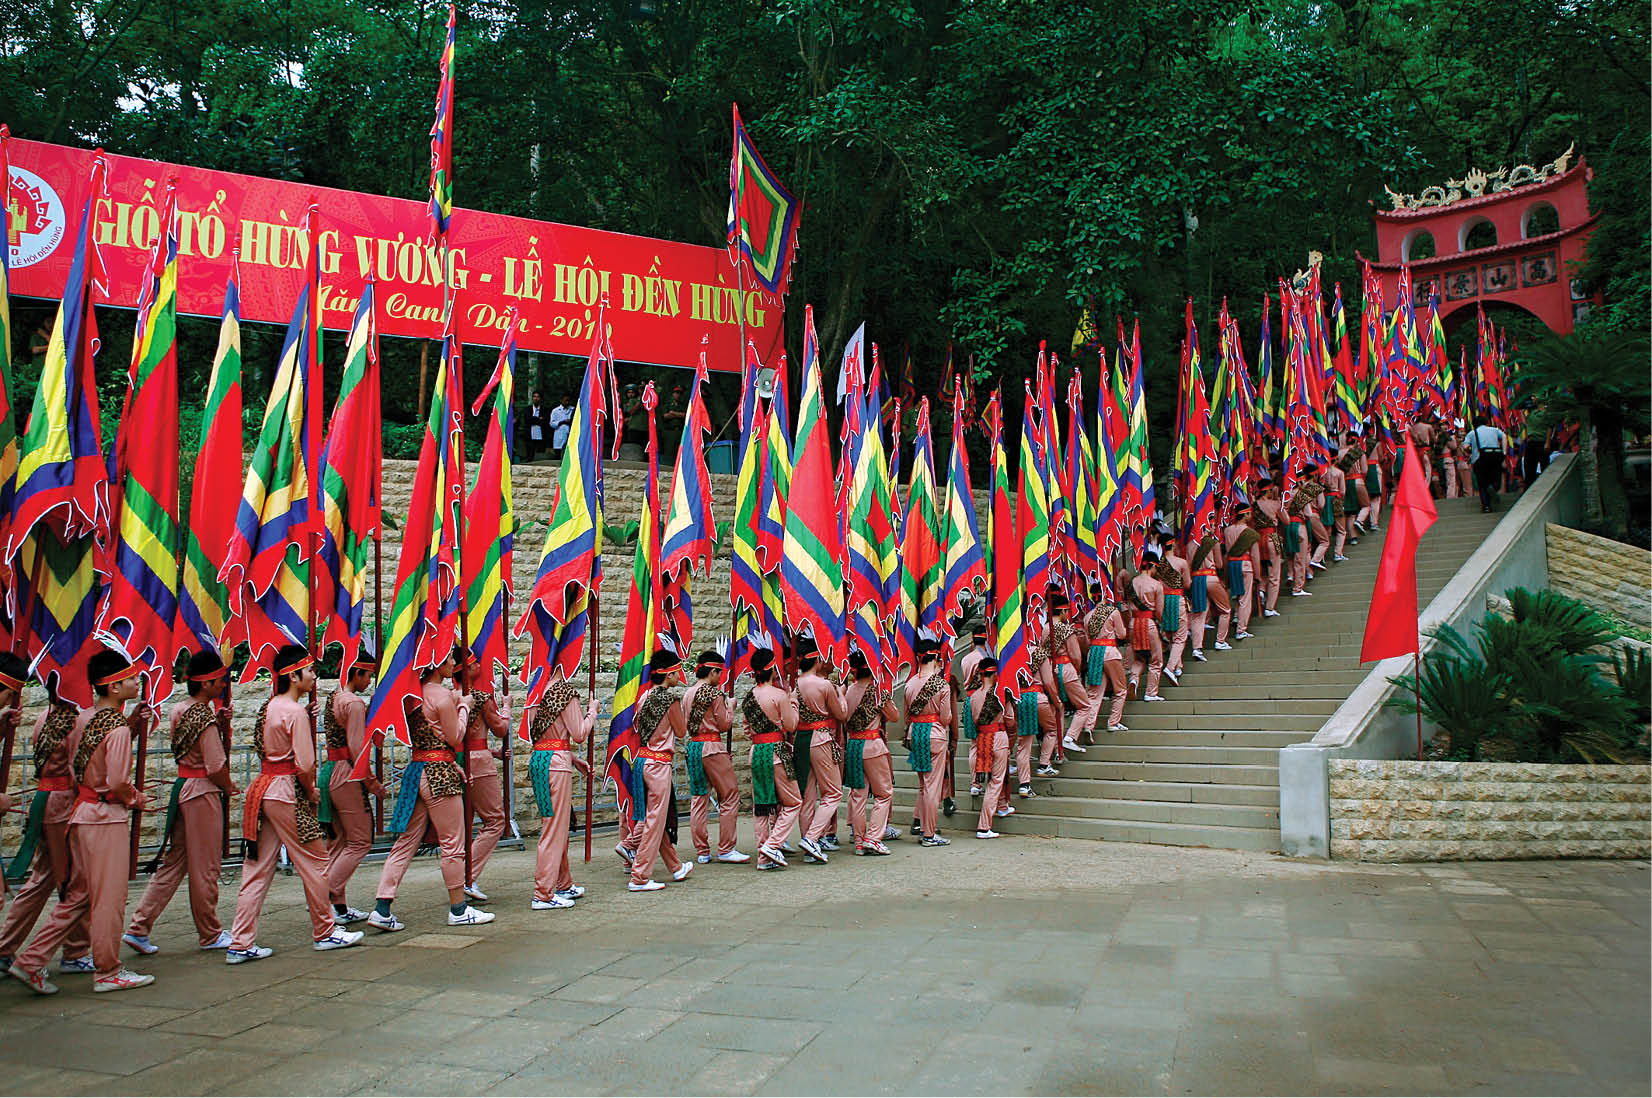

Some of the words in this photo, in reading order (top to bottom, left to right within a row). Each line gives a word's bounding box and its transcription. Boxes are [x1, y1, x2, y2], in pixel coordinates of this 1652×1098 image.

[96, 178, 160, 250] GIỖ
[177, 190, 226, 259] TỔ
[353, 231, 469, 290] VƯƠNG
[503, 235, 543, 303] LỄ
[553, 255, 611, 322] HỘI
[621, 255, 682, 318] ĐỀN
[690, 273, 765, 328] HÙNG
